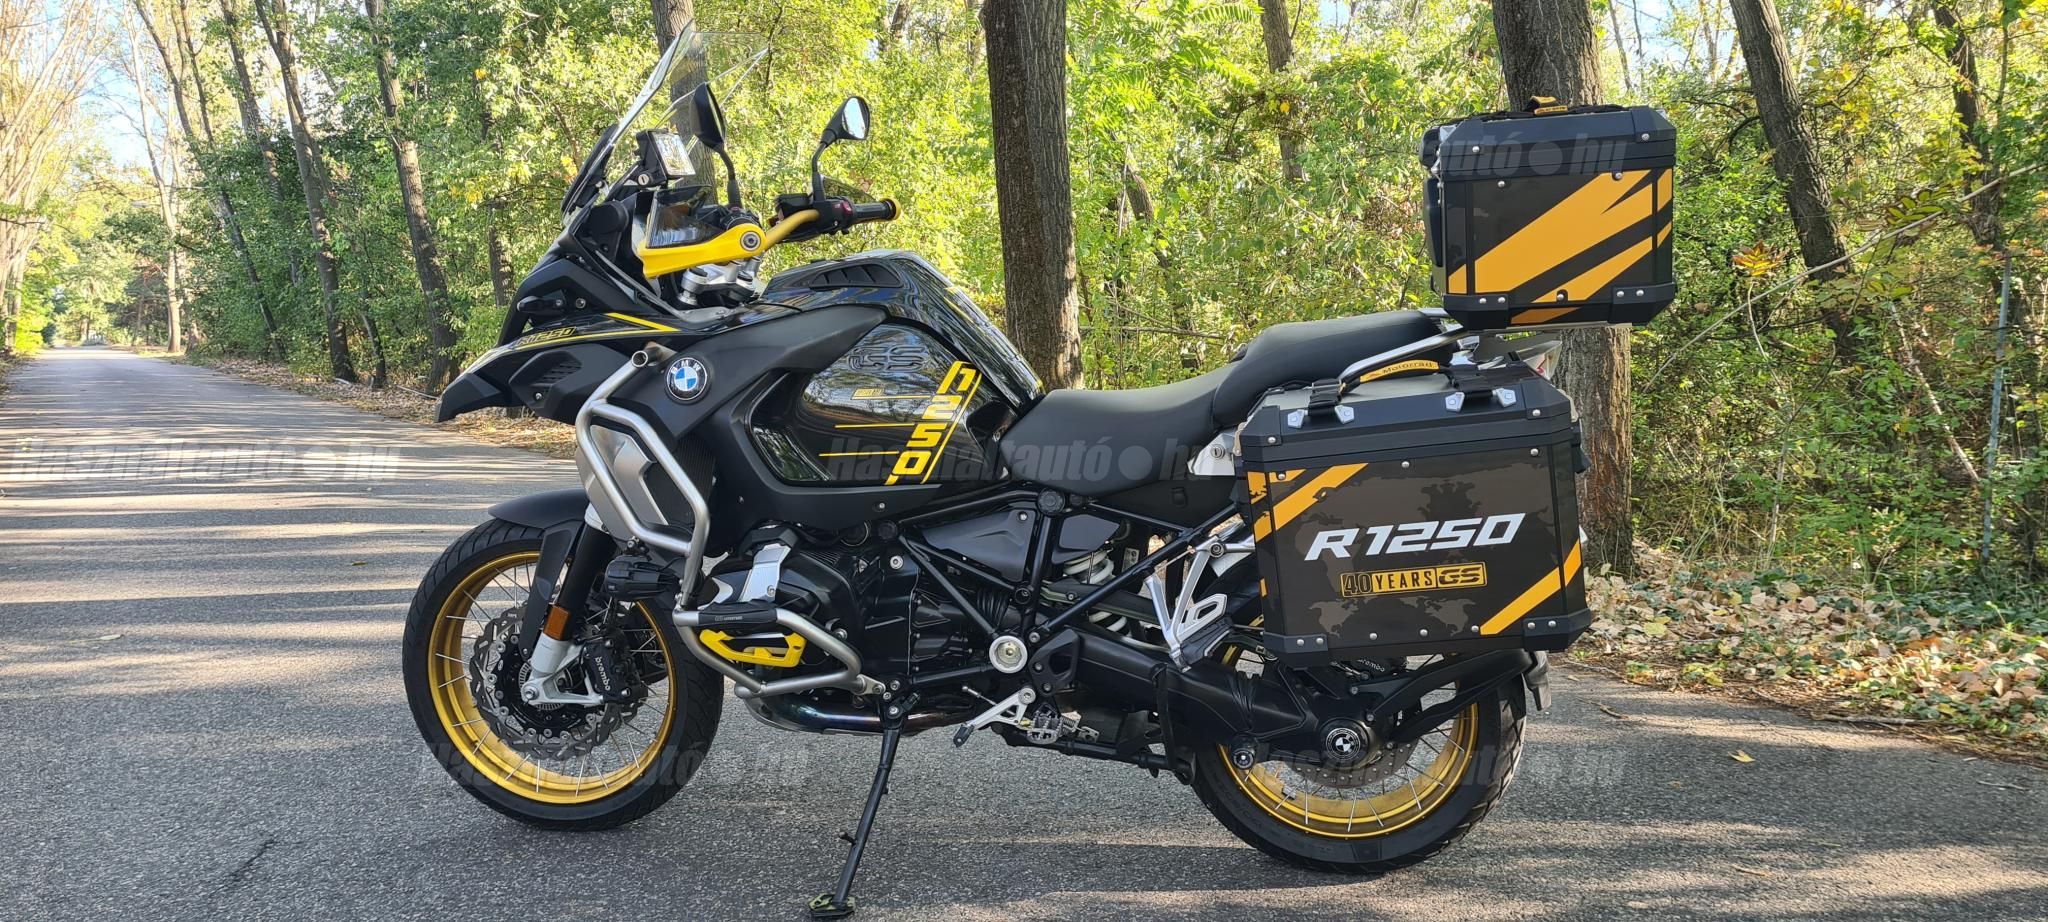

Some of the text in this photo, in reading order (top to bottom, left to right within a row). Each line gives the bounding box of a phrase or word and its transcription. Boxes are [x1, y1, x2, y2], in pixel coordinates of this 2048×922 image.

[671, 359, 702, 375] BMW
[1373, 570, 1434, 590] YEARS
[594, 656, 611, 692] brembo
